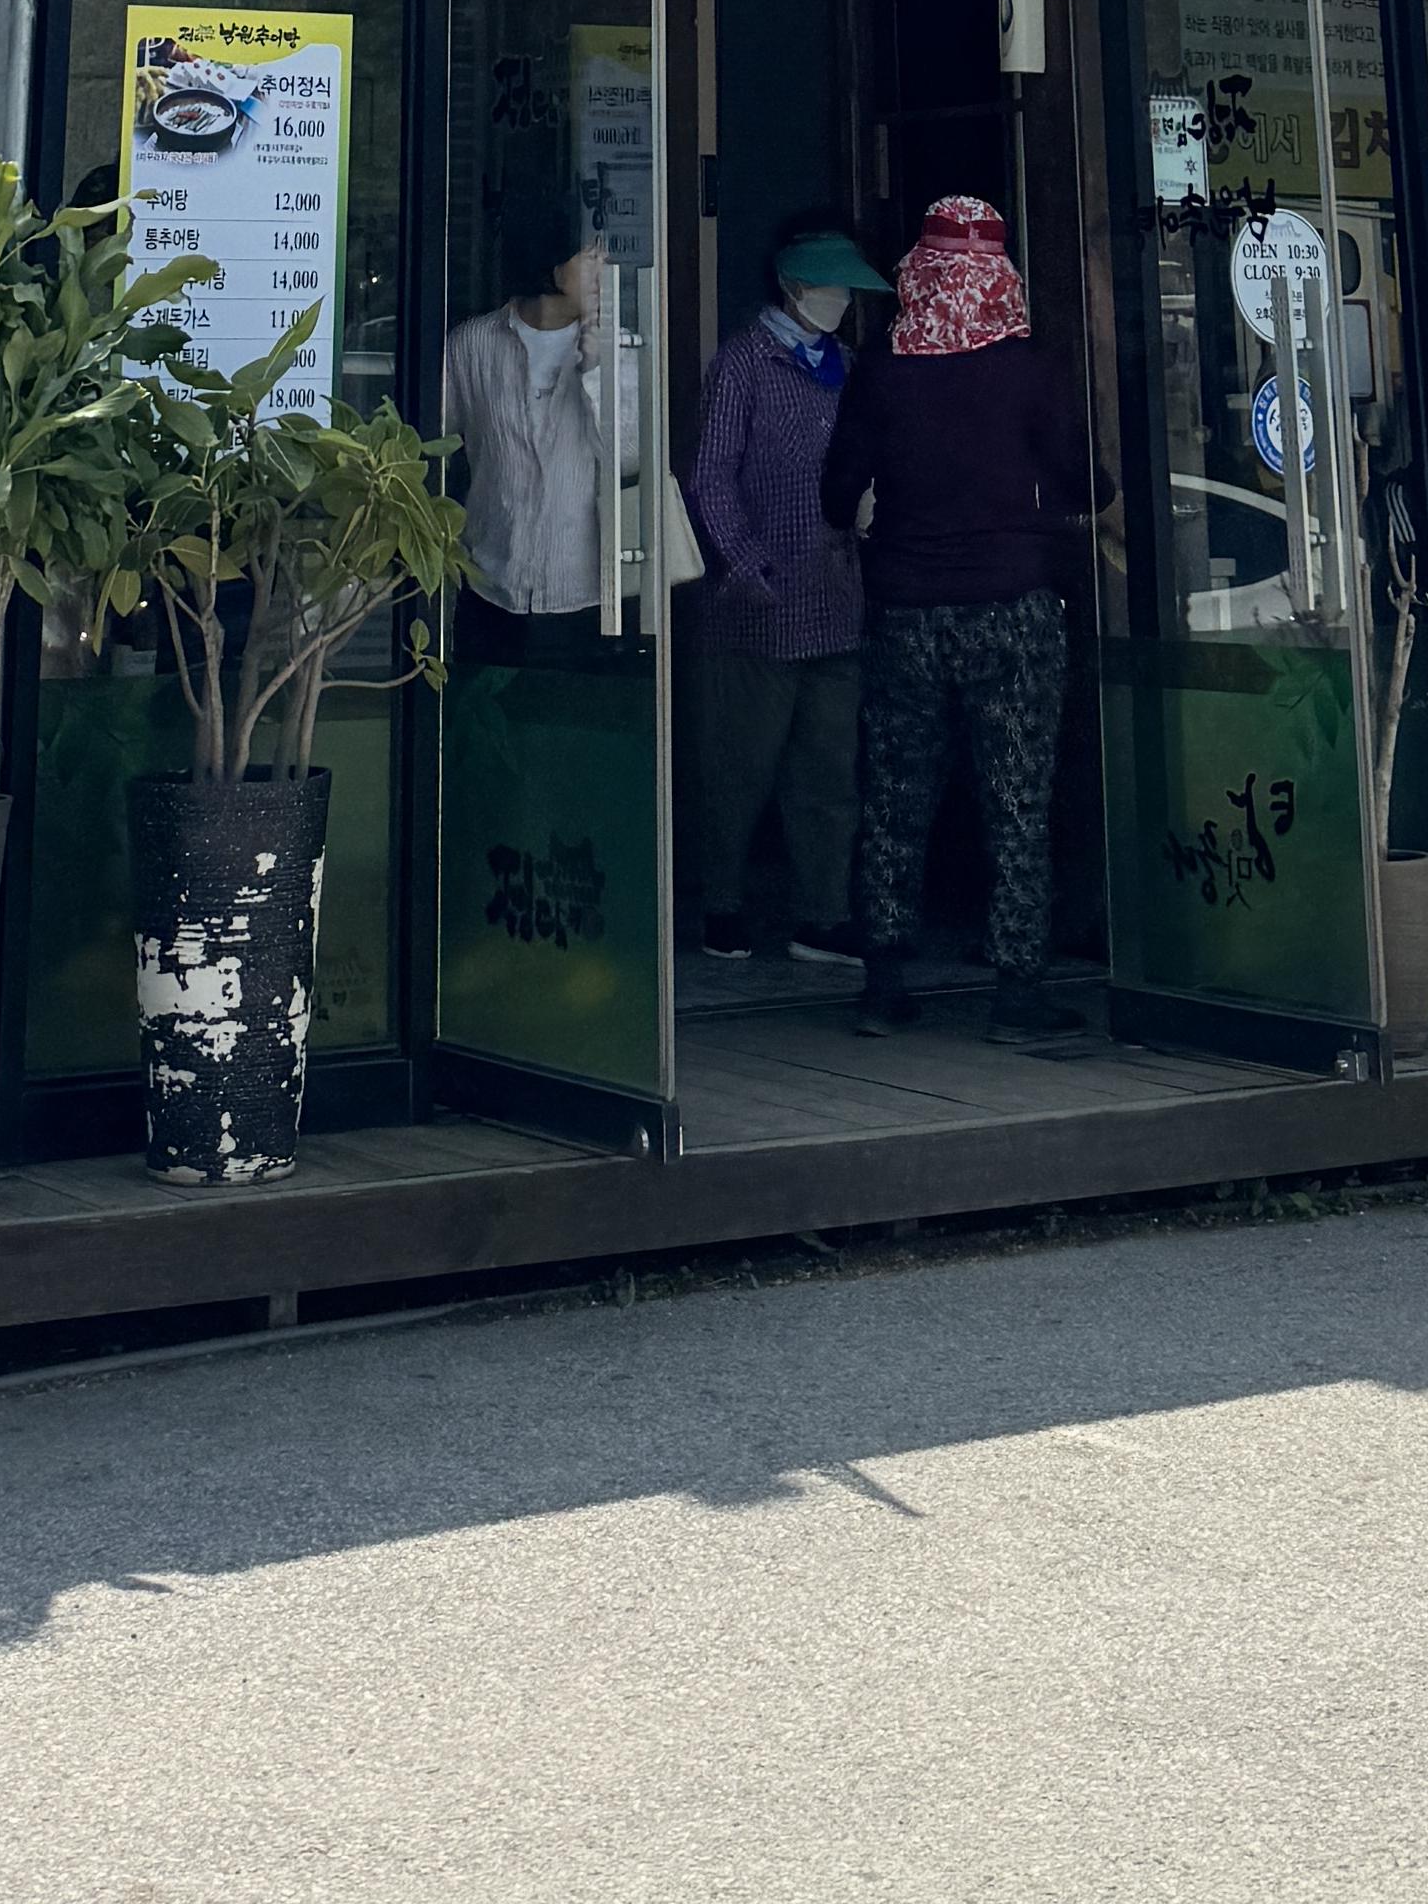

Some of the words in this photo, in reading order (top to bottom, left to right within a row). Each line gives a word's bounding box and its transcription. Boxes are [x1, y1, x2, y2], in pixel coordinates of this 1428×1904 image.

[218, 22, 302, 49] 남원추어탕
[259, 74, 332, 99] 추어정식
[273, 116, 326, 139] 16,000
[274, 192, 321, 213] 12,000
[143, 228, 201, 252] 통추어탕
[273, 232, 320, 252] 14,000
[1242, 243, 1278, 260] OPEN
[1287, 244, 1320, 260] 10:30
[272, 270, 318, 291] 14,000
[1243, 263, 1287, 281] CLOSE
[1295, 265, 1321, 281] 9:30
[269, 389, 315, 409] 18,000
